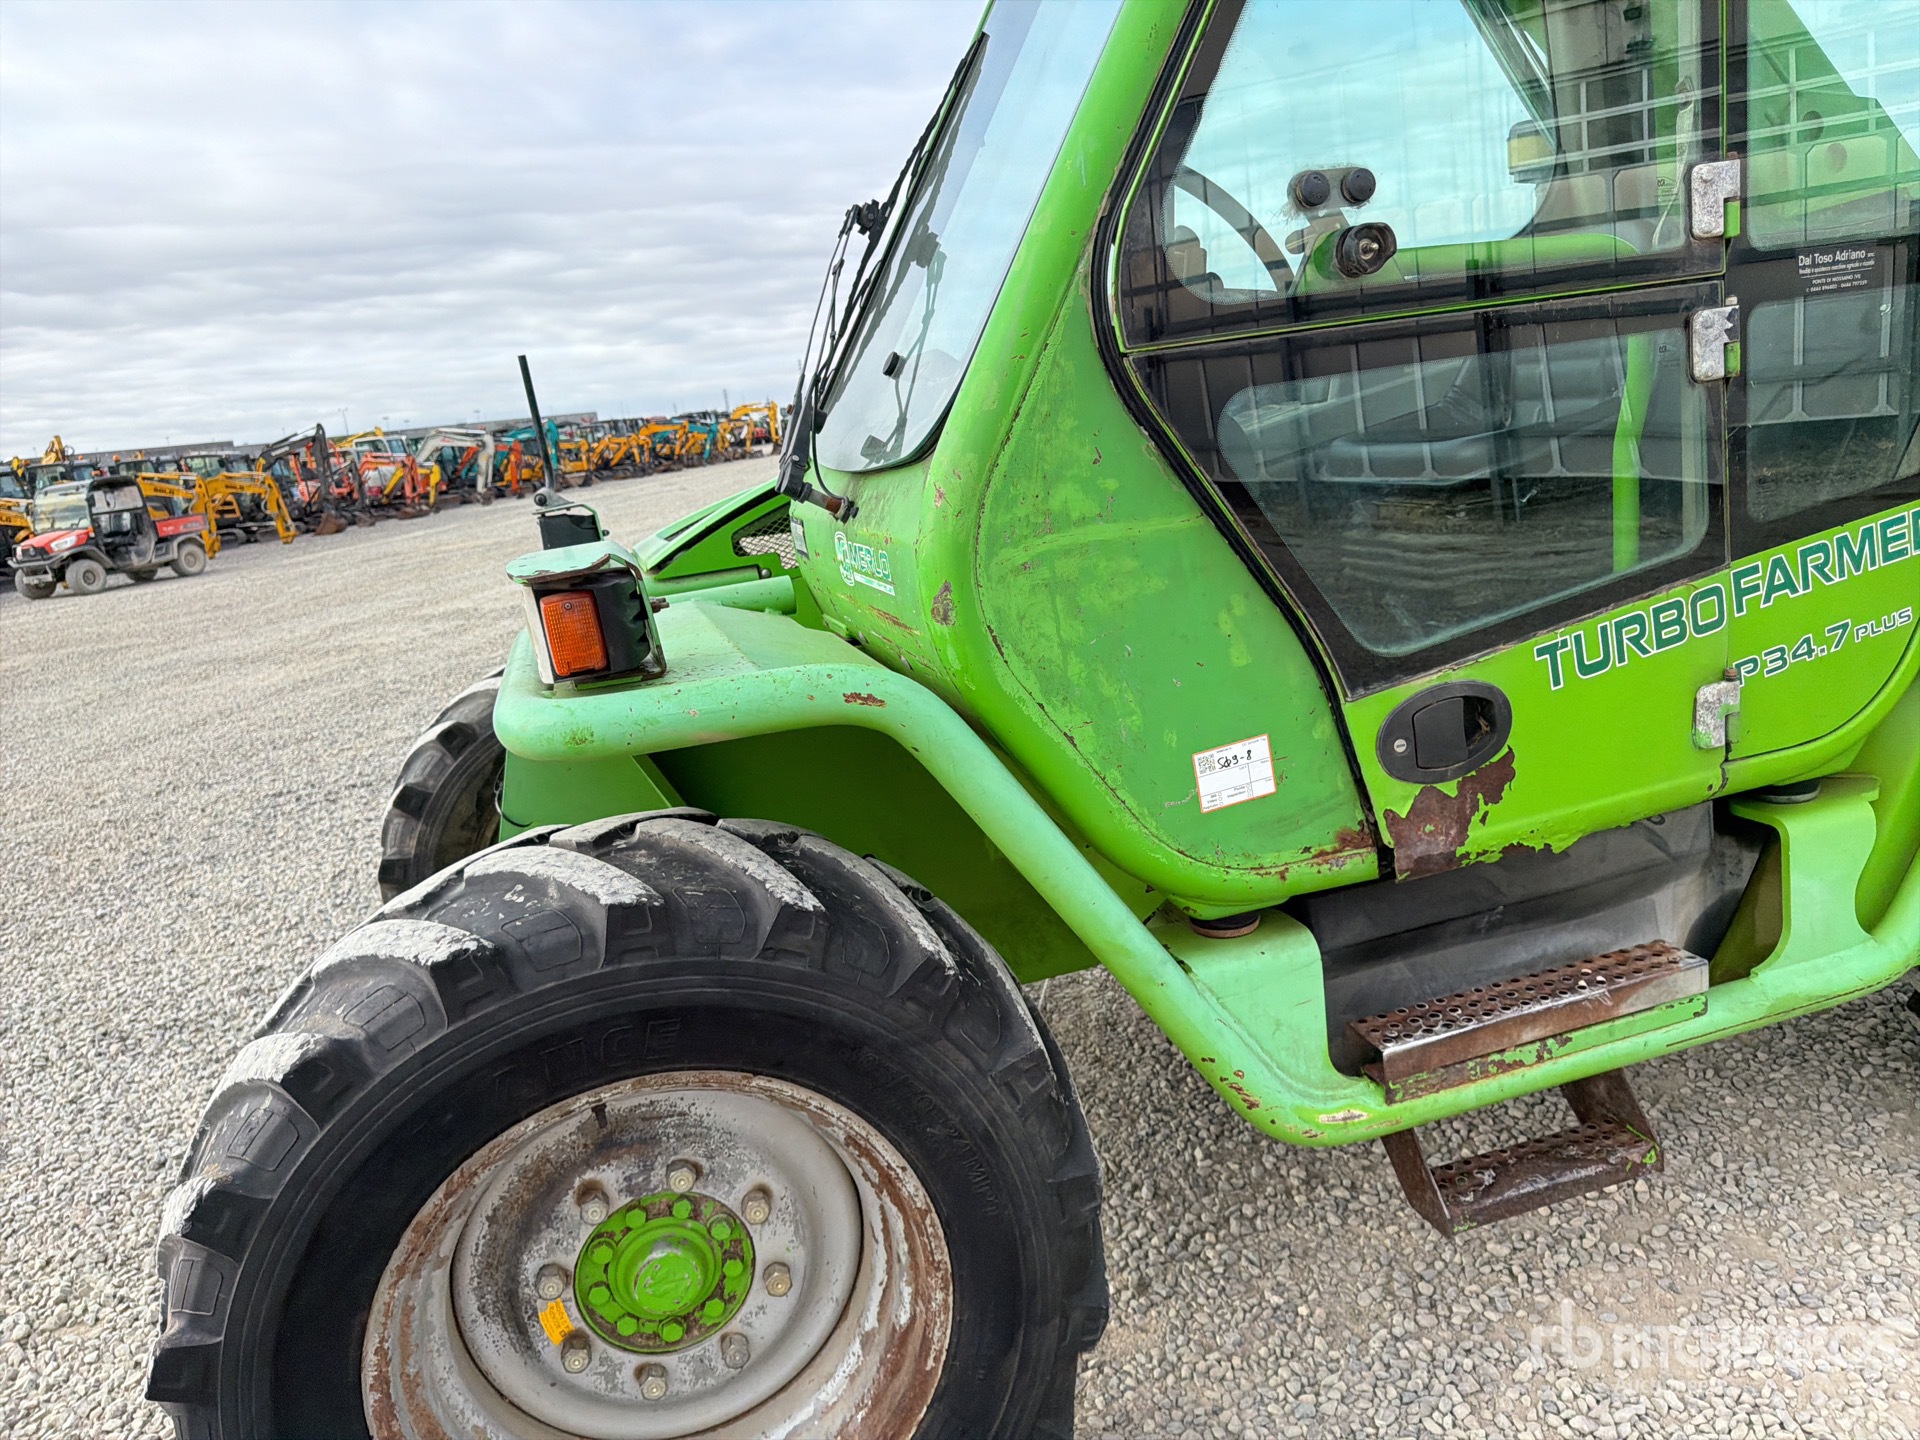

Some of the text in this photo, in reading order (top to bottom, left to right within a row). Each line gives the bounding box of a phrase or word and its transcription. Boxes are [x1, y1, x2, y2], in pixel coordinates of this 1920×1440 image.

[1798, 254, 1812, 266] Dal
[1814, 252, 1833, 264] Toso
[1834, 249, 1866, 262] Adriano
[1733, 606, 1913, 688] P34.7 PLUS
